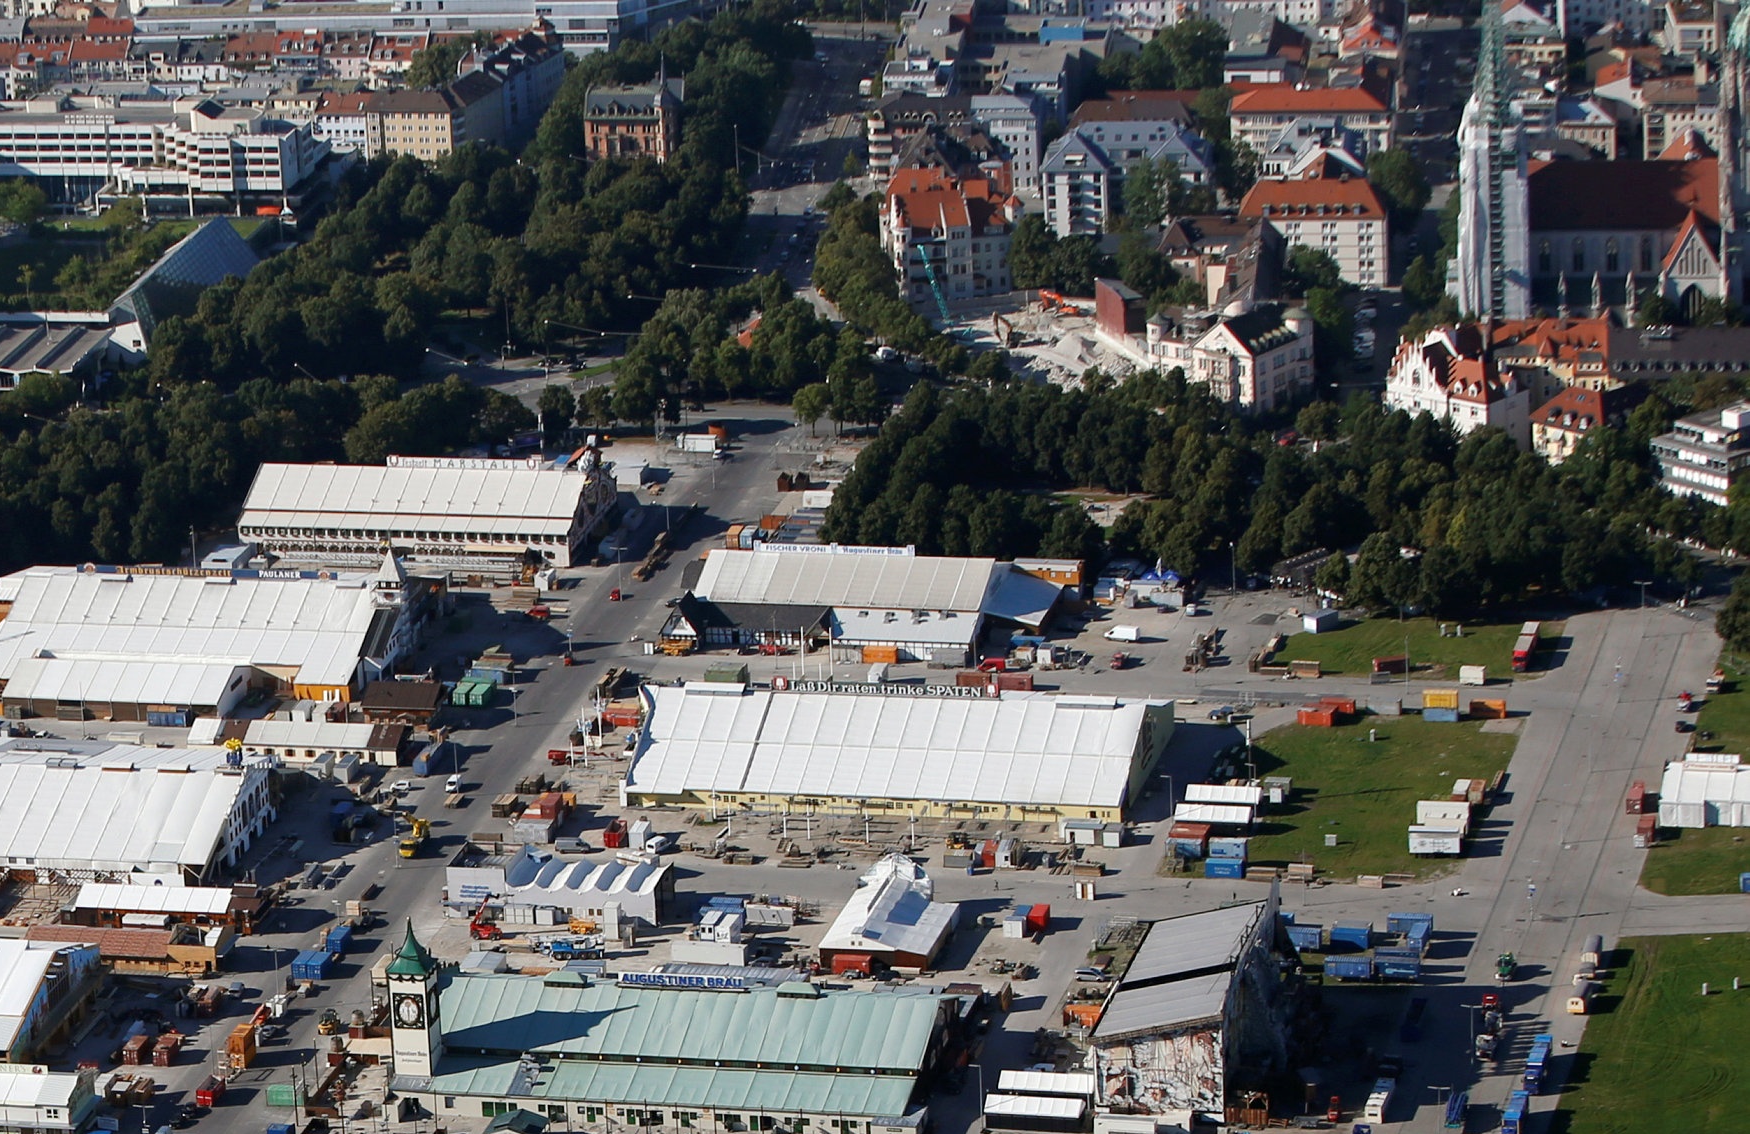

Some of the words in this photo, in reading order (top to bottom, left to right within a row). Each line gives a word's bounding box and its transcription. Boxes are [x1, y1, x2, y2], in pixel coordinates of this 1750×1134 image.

[433, 458, 518, 469] MARSTALL
[765, 544, 797, 552] FISCHER
[799, 545, 827, 553] VRONI
[842, 546, 885, 555] Augustiner
[258, 569, 301, 579] PAULANER
[790, 680, 816, 692] Laß
[818, 681, 838, 692] Dir
[926, 685, 982, 697] SPATEN
[622, 973, 706, 987] AUGUSTINER
[707, 975, 742, 988] BRÄU
